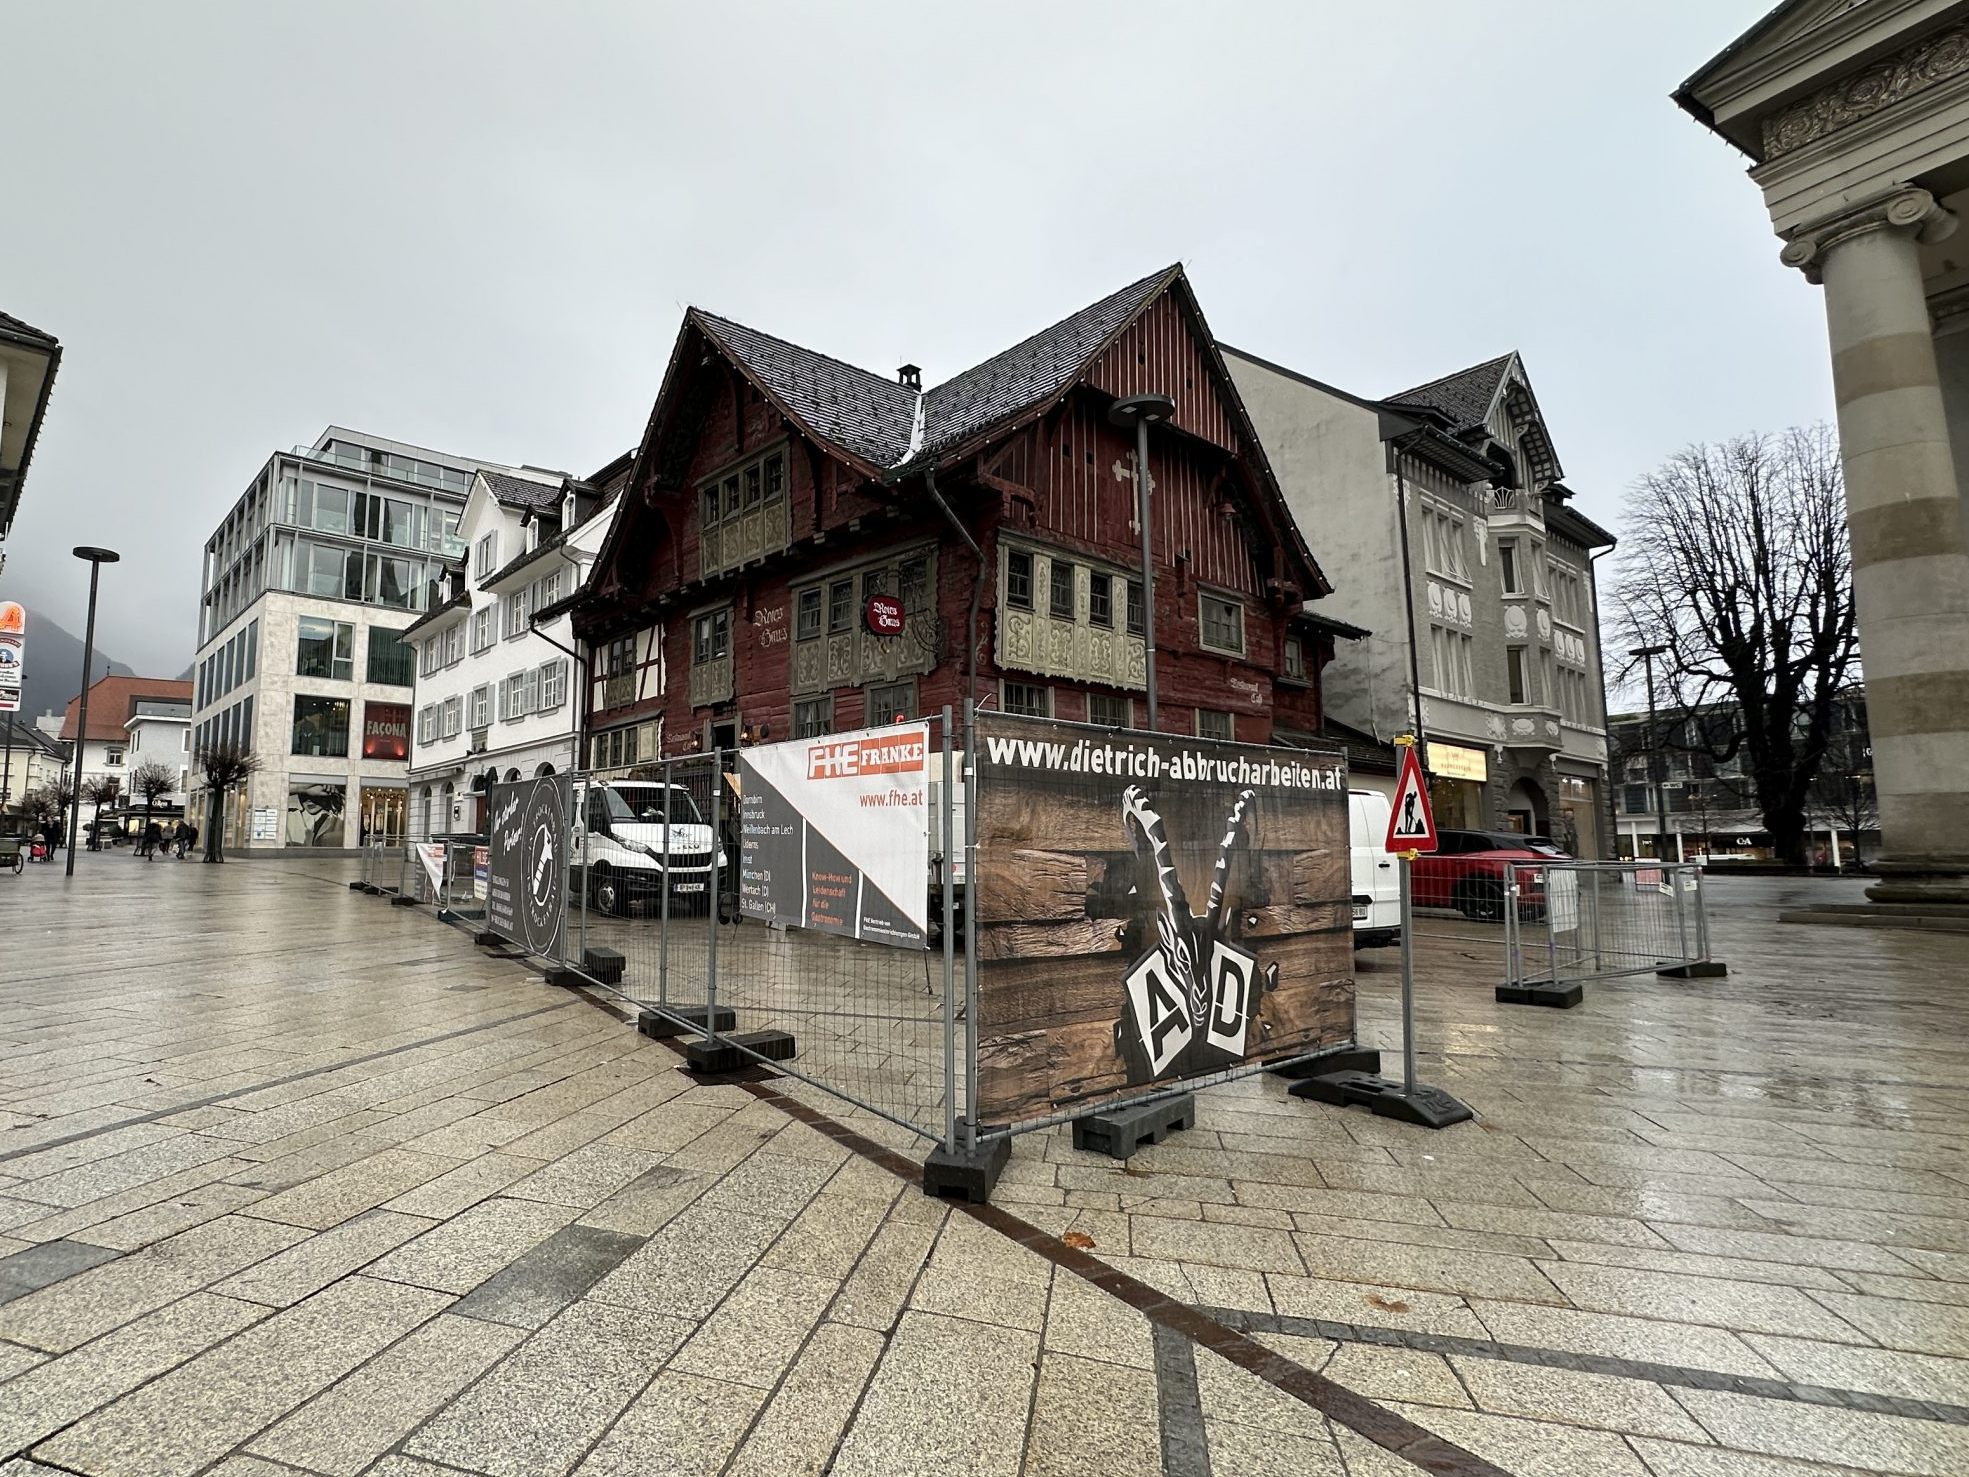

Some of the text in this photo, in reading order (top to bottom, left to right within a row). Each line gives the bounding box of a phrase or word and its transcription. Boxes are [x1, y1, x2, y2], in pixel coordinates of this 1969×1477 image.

[366, 720, 407, 738] FAÇONA
[808, 742, 924, 778] FHE FRANKE
[986, 736, 1342, 790] www.dietrich-abbrucharbeiten.at
[368, 791, 404, 800] MANGO
[860, 788, 924, 808] www.fhe.at
[743, 809, 765, 819] Innsbruck
[771, 826, 780, 835] am
[780, 824, 793, 835] Lech
[742, 868, 763, 880] München
[748, 899, 764, 911] Gallen
[1145, 955, 1245, 1062] A D
